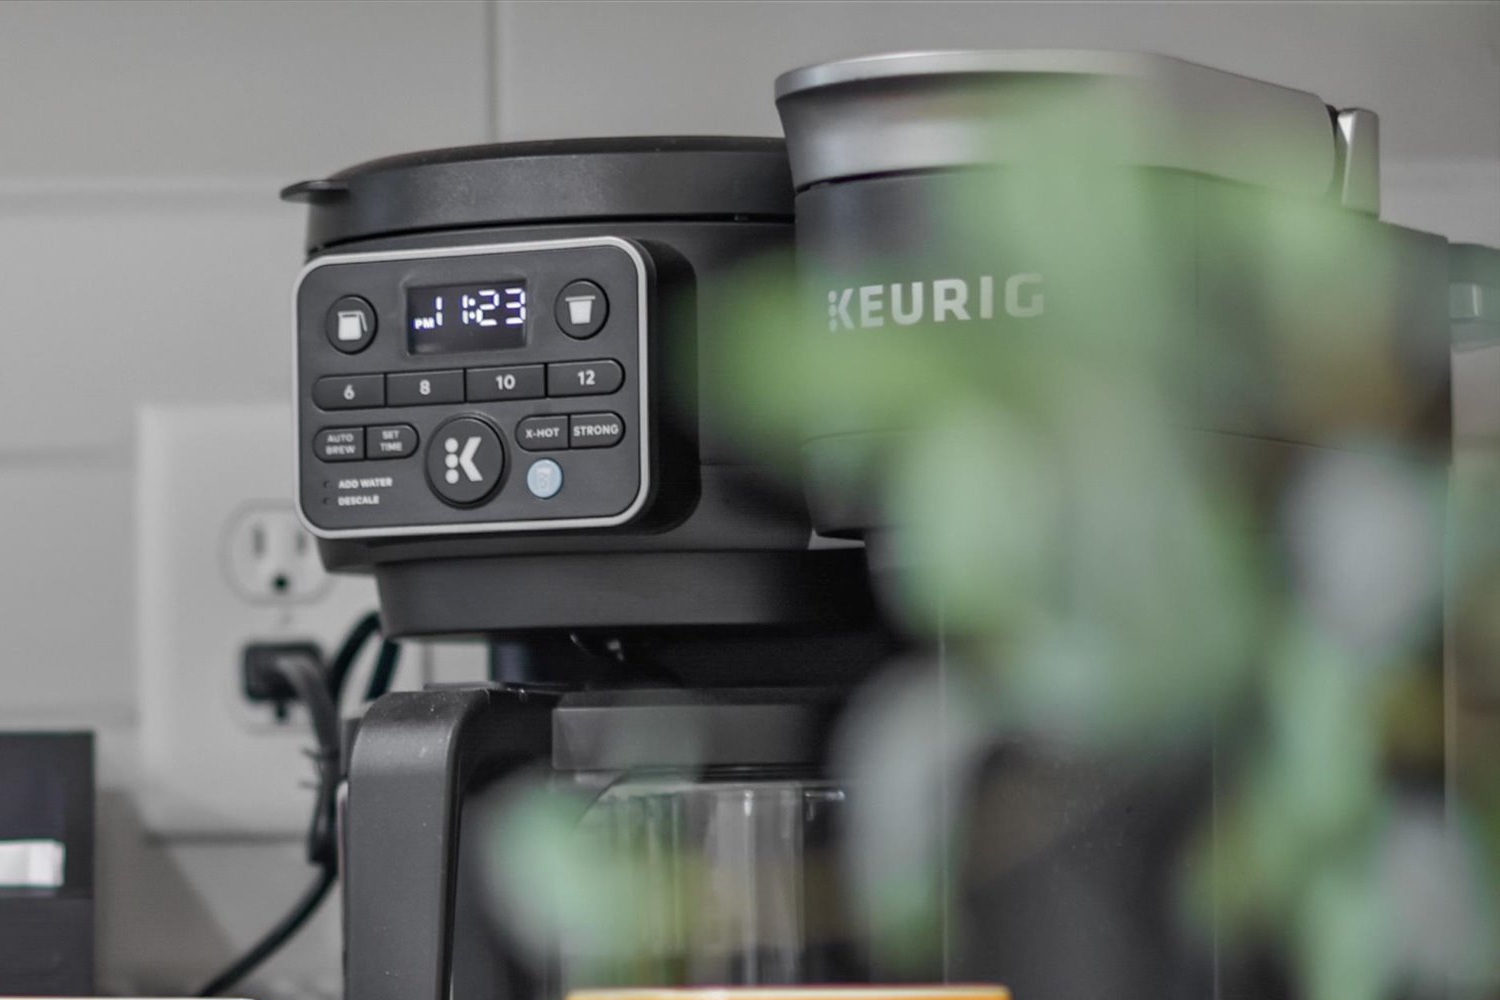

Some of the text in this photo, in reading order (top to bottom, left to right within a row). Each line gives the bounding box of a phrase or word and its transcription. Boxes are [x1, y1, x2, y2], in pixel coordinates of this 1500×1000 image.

[414, 287, 527, 330] PM 11:23
[828, 273, 1045, 333] KEURIG
[496, 374, 516, 390] 10
[577, 370, 596, 386] 12
[343, 385, 355, 400] 6
[419, 380, 431, 395] 8
[382, 430, 399, 440] SET
[525, 427, 560, 439] X-HOT
[573, 423, 619, 437] STRONG
[326, 433, 354, 443] AUTO
[325, 445, 356, 455] BREW
[380, 442, 403, 452] TIME
[338, 477, 393, 489] ADD WATER
[338, 494, 380, 506] DESCALE
